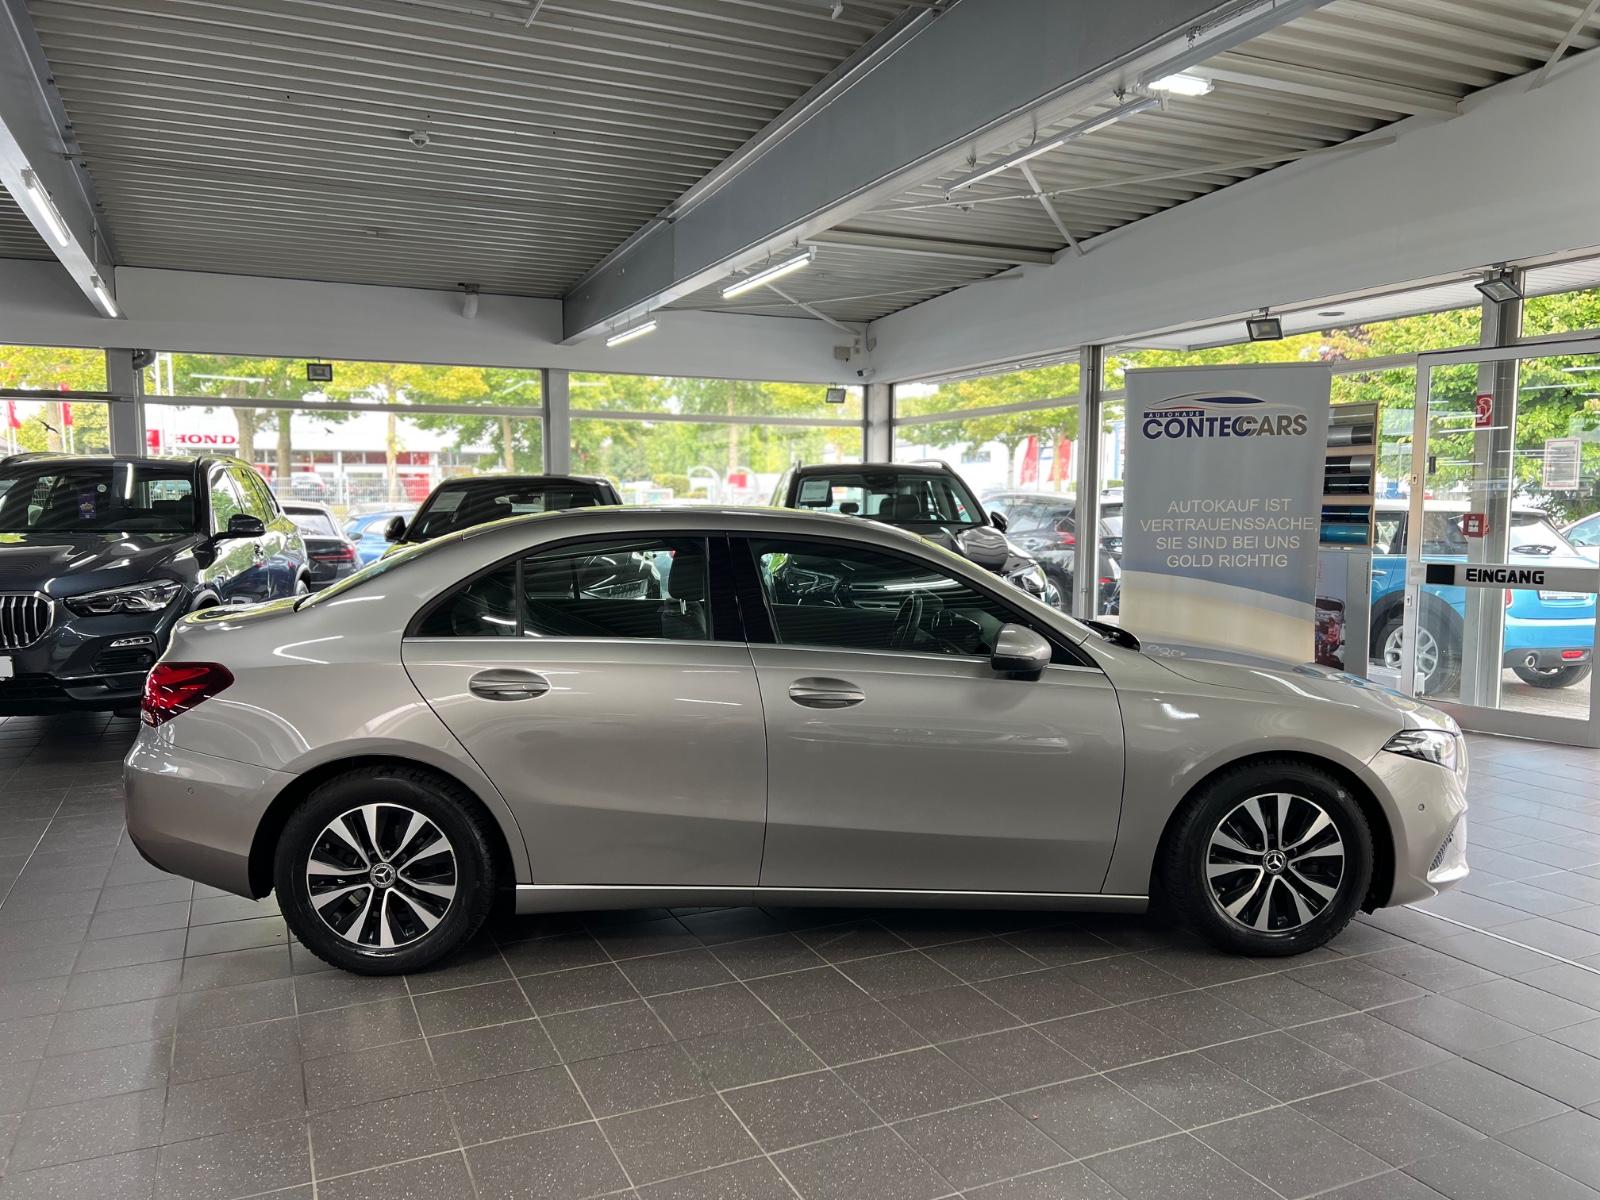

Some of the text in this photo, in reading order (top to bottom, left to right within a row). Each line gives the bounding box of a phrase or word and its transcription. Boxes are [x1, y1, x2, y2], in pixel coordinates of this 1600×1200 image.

[176, 434, 240, 444] HOND
[1167, 498, 1292, 513] AUTOKAUF IST
[1156, 535, 1300, 550] SIE SIND BEI UNS
[1166, 554, 1288, 568] GOLD RICHTIG
[1466, 568, 1544, 585] EINGANG
